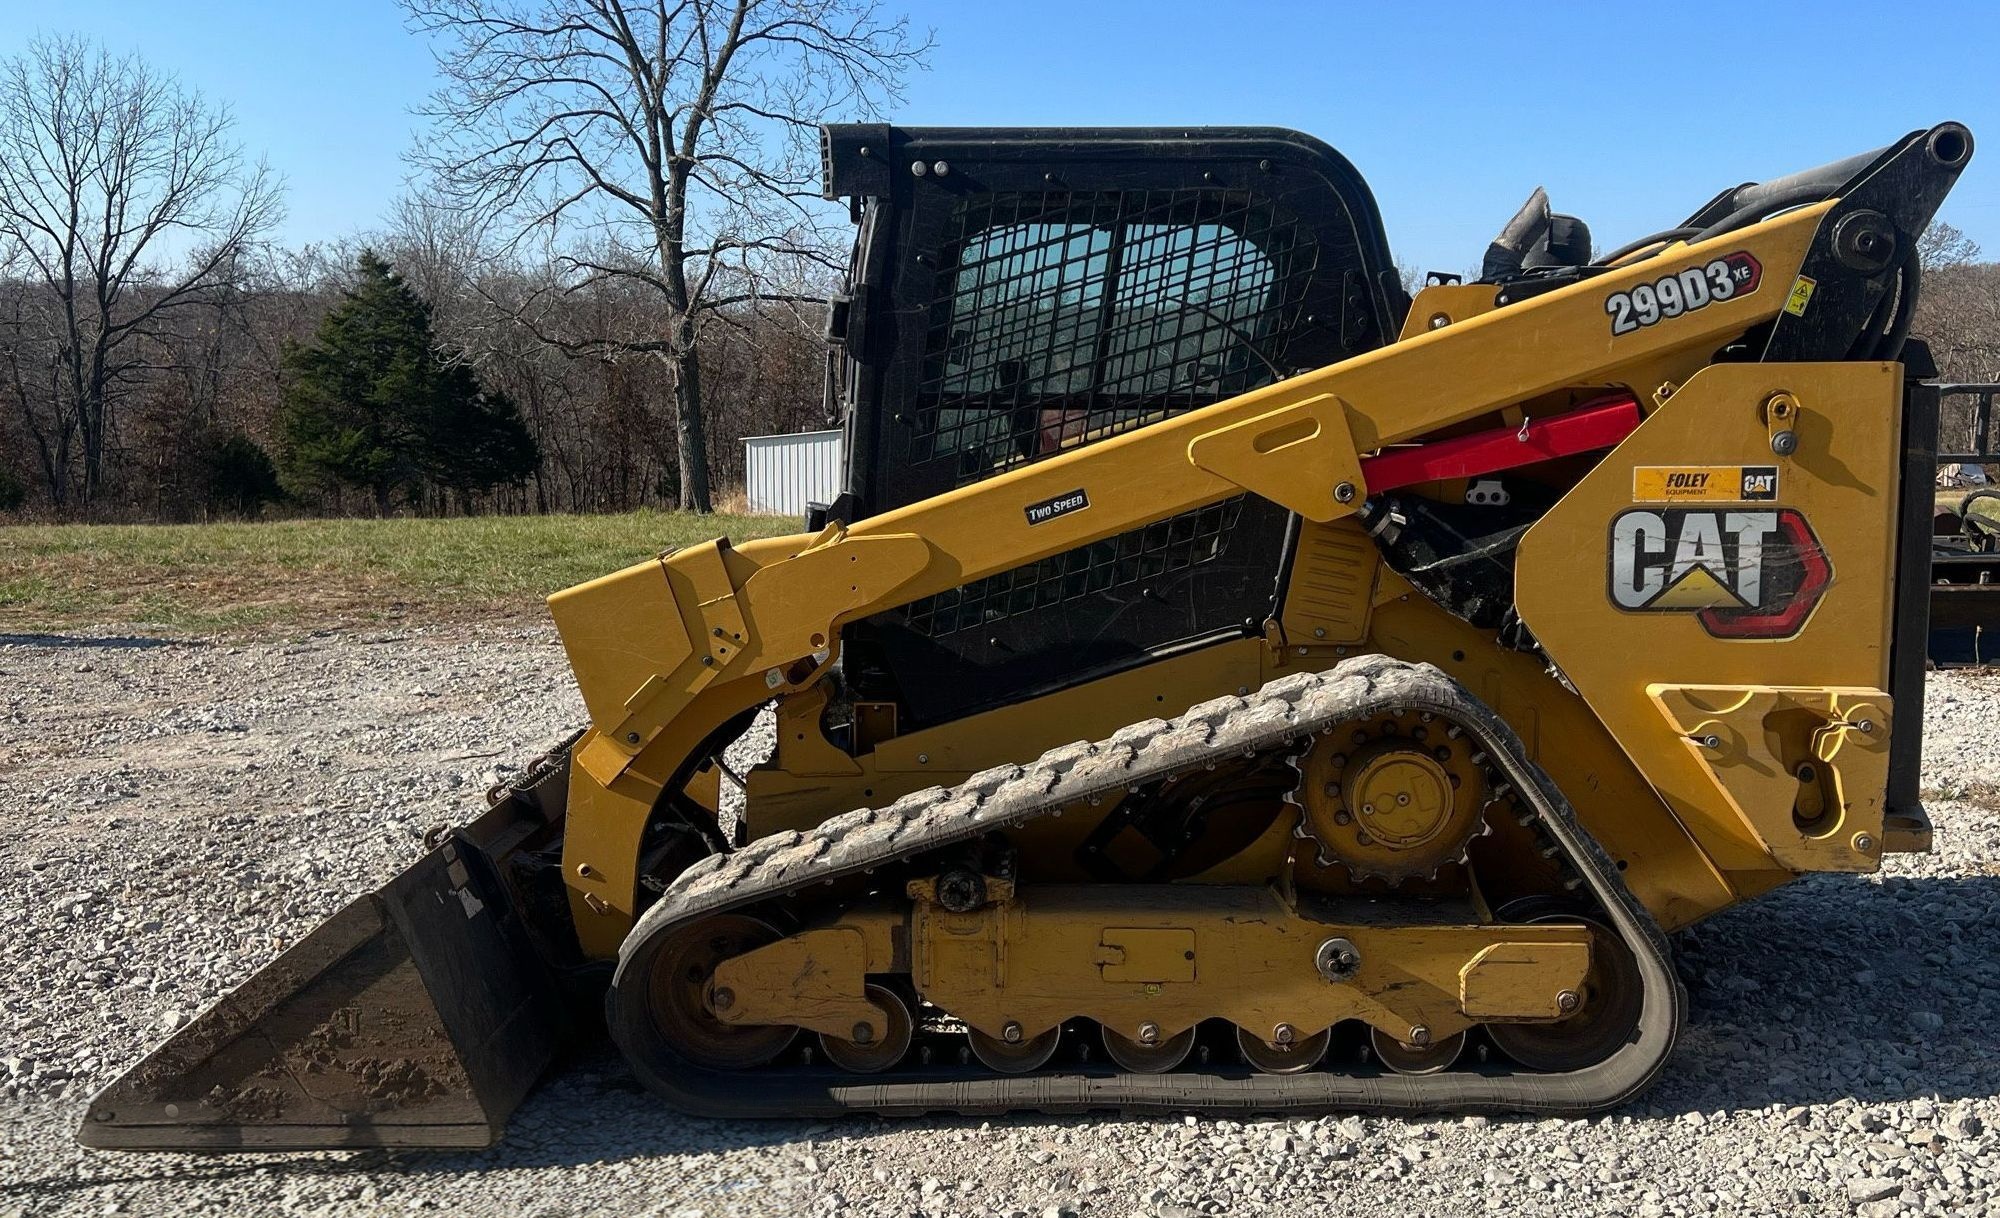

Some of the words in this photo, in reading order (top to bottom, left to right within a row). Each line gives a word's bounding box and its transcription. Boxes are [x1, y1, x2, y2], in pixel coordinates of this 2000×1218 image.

[1607, 260, 1735, 334] 299D3
[1733, 265, 1750, 282] XE
[1666, 473, 1710, 488] FOLEY
[1744, 475, 1774, 492] CAT
[1665, 488, 1707, 496] EQUIPMENT
[1029, 505, 1051, 520] TWO
[1053, 495, 1083, 513] SPEED
[1614, 511, 1777, 608] CAT
